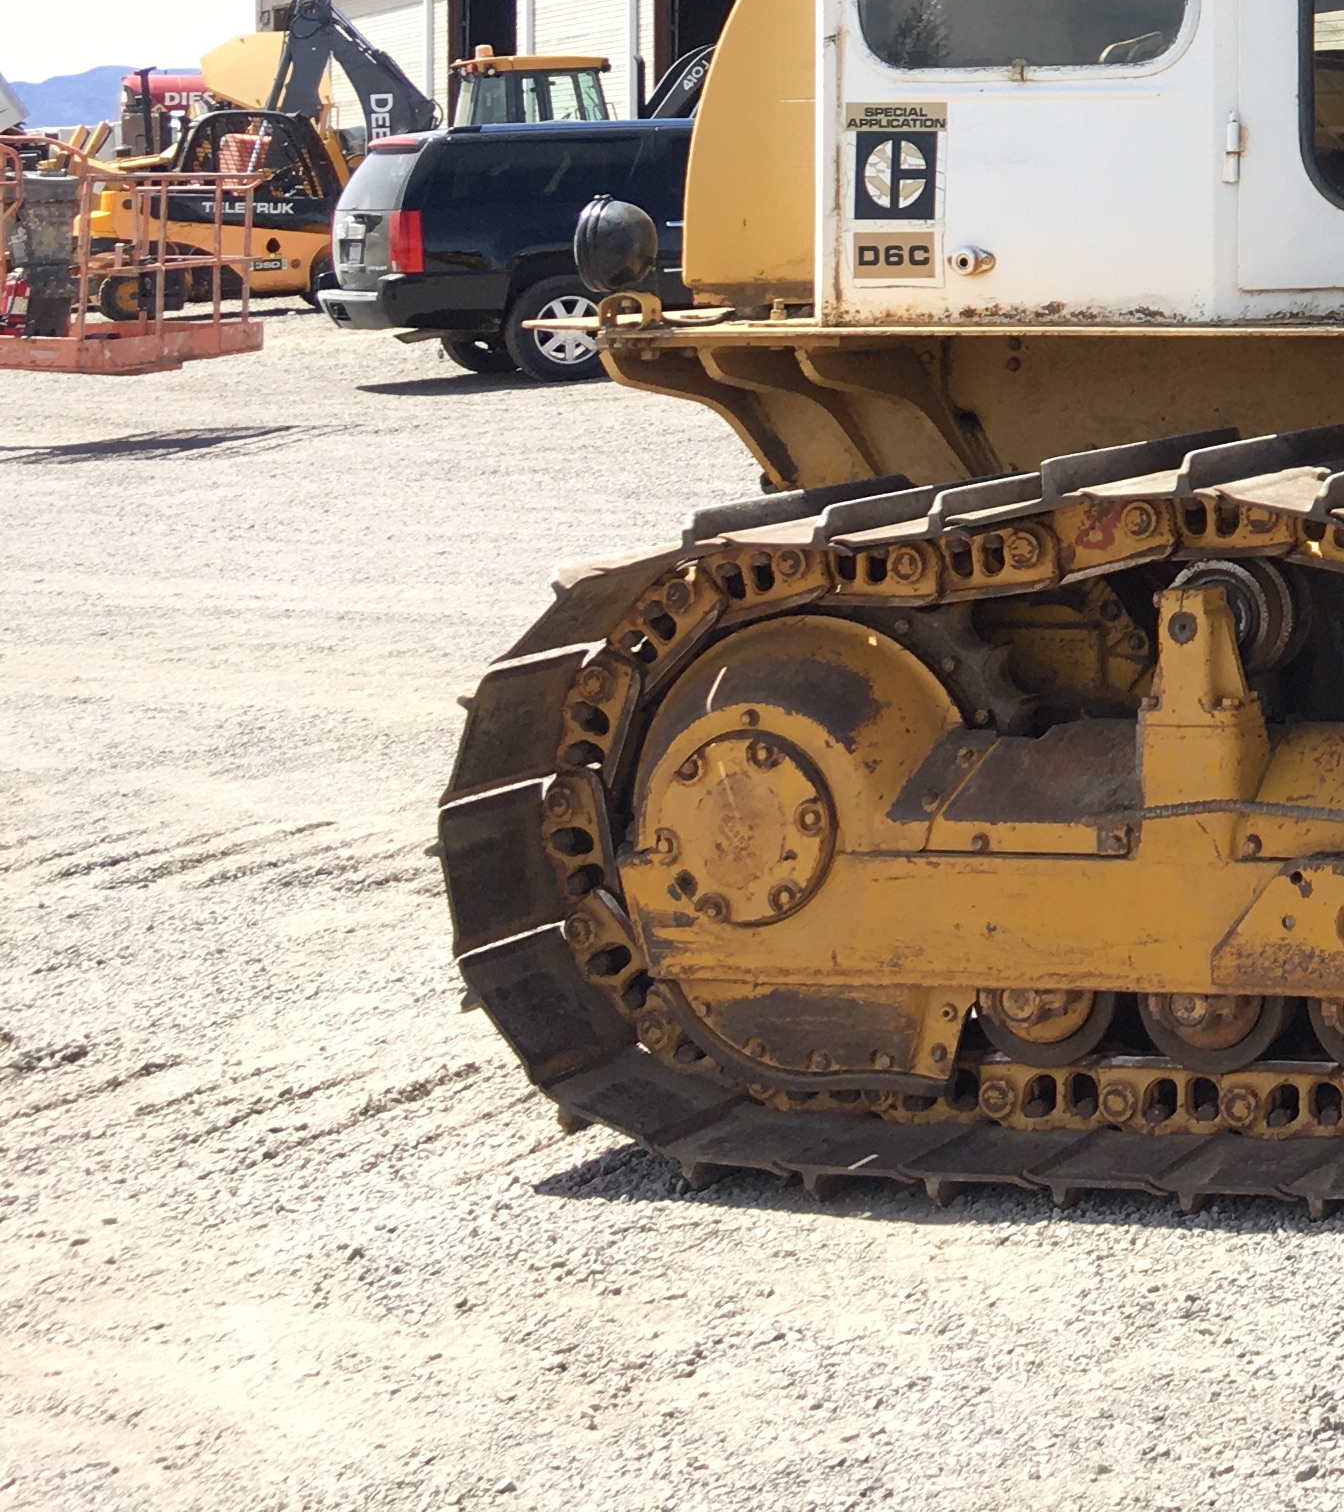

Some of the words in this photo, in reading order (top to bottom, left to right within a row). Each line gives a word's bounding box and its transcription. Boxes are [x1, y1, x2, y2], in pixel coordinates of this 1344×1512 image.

[864, 107, 928, 117] SPECIAL
[846, 118, 946, 129] APPLICATION
[857, 245, 930, 266] D6C
